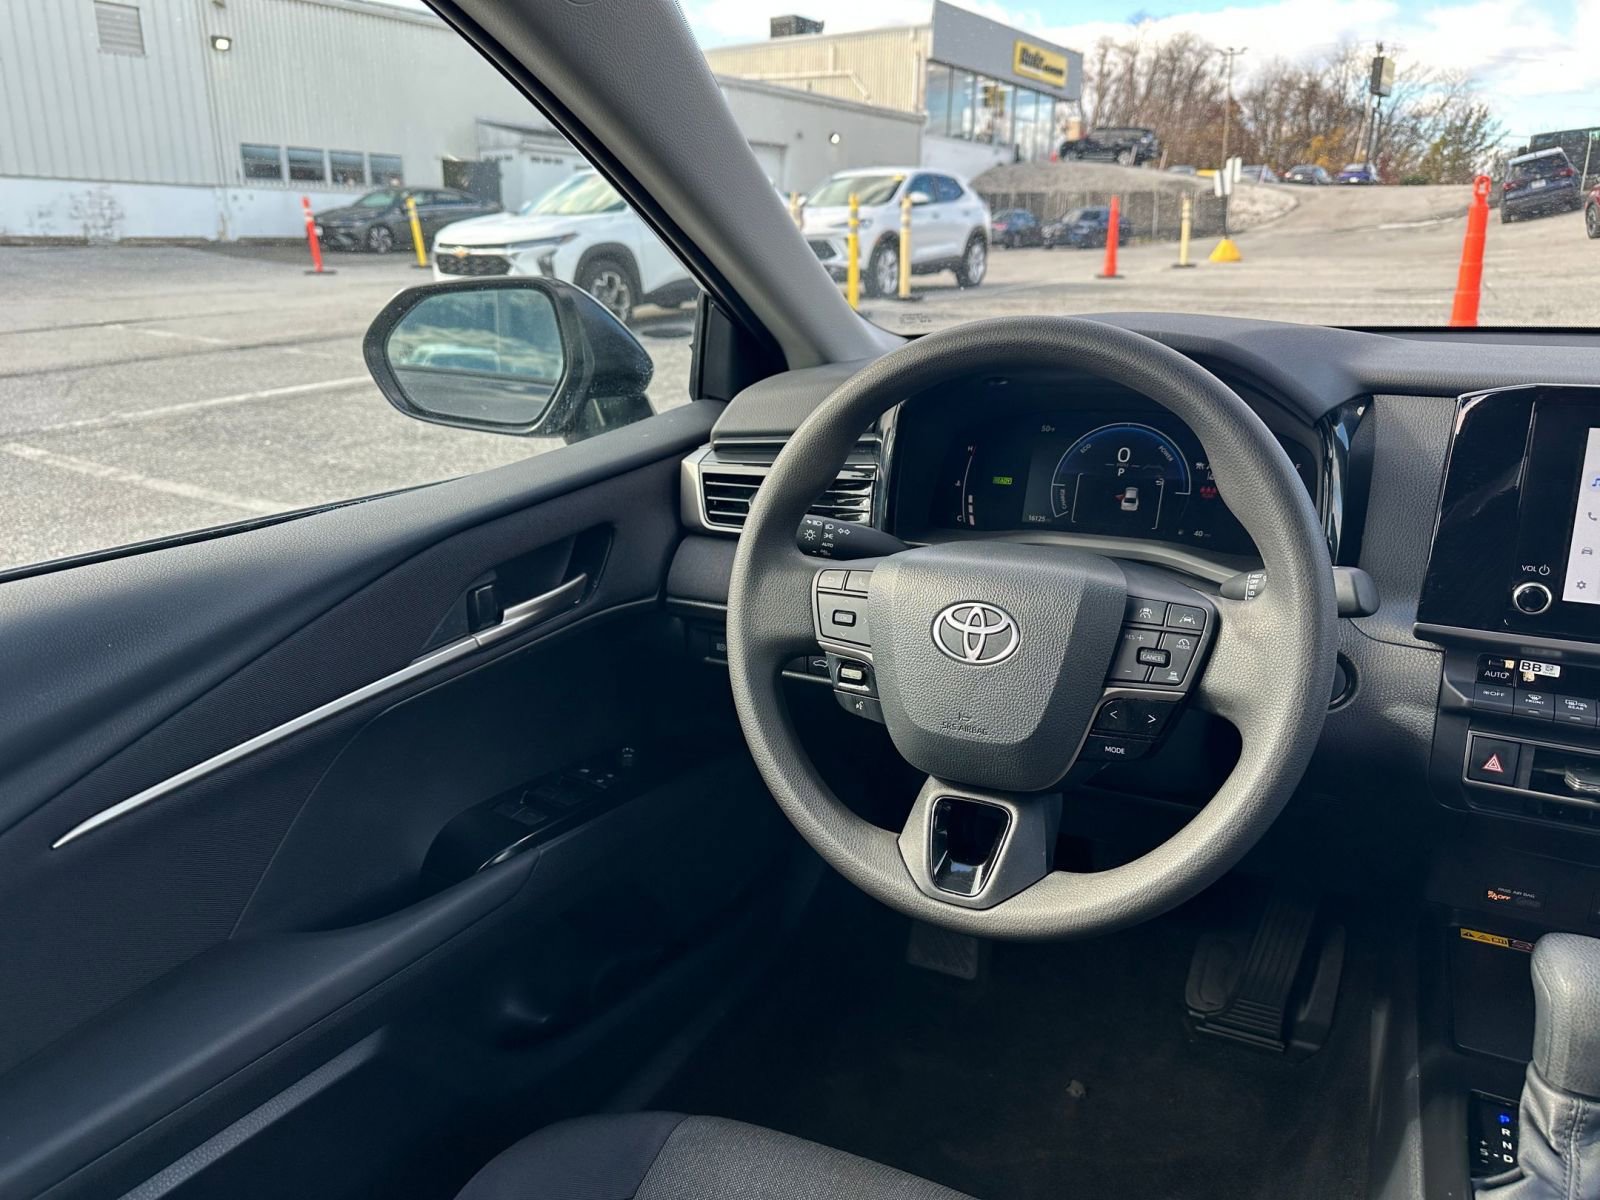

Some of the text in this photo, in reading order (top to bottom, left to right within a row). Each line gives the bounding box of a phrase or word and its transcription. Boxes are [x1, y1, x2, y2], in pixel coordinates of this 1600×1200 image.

[1117, 447, 1131, 463] 0
[1117, 468, 1125, 477] P
[1521, 564, 1537, 573] VOL
[1142, 653, 1164, 662] CANCEL
[1521, 661, 1542, 673] BB
[1484, 670, 1508, 680] AUTO
[1104, 745, 1126, 755] MODE
[1501, 1127, 1511, 1137] R
[1502, 1140, 1512, 1150] N
[1503, 1154, 1514, 1164] D
